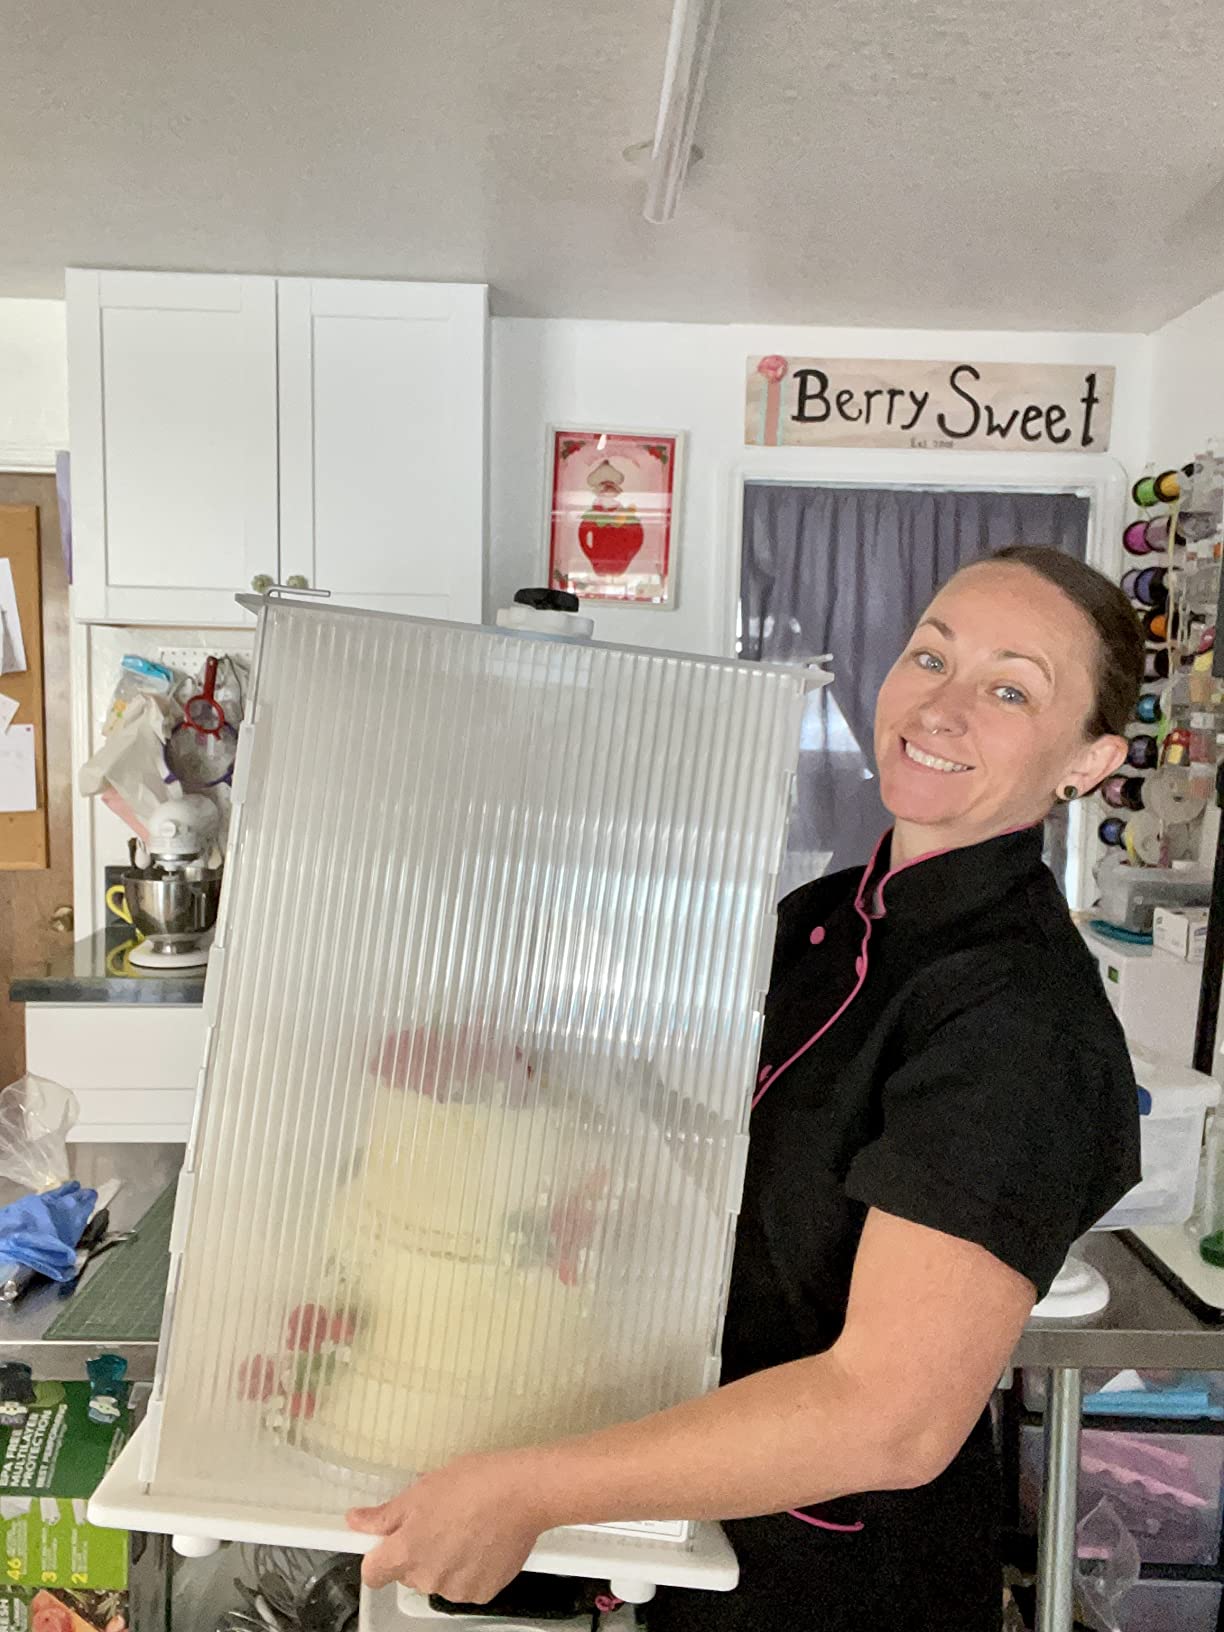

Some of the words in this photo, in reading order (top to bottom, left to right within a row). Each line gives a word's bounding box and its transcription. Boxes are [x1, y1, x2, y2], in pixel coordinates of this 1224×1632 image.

[790, 368, 929, 431] Berry
[937, 364, 1099, 447] Sweet
[10, 1413, 39, 1487] MULTILAYER
[21, 1409, 52, 1488] PROTECTION
[6, 1558, 21, 1581] 46
[41, 1571, 57, 1583] 3
[71, 1572, 88, 1585] 2
